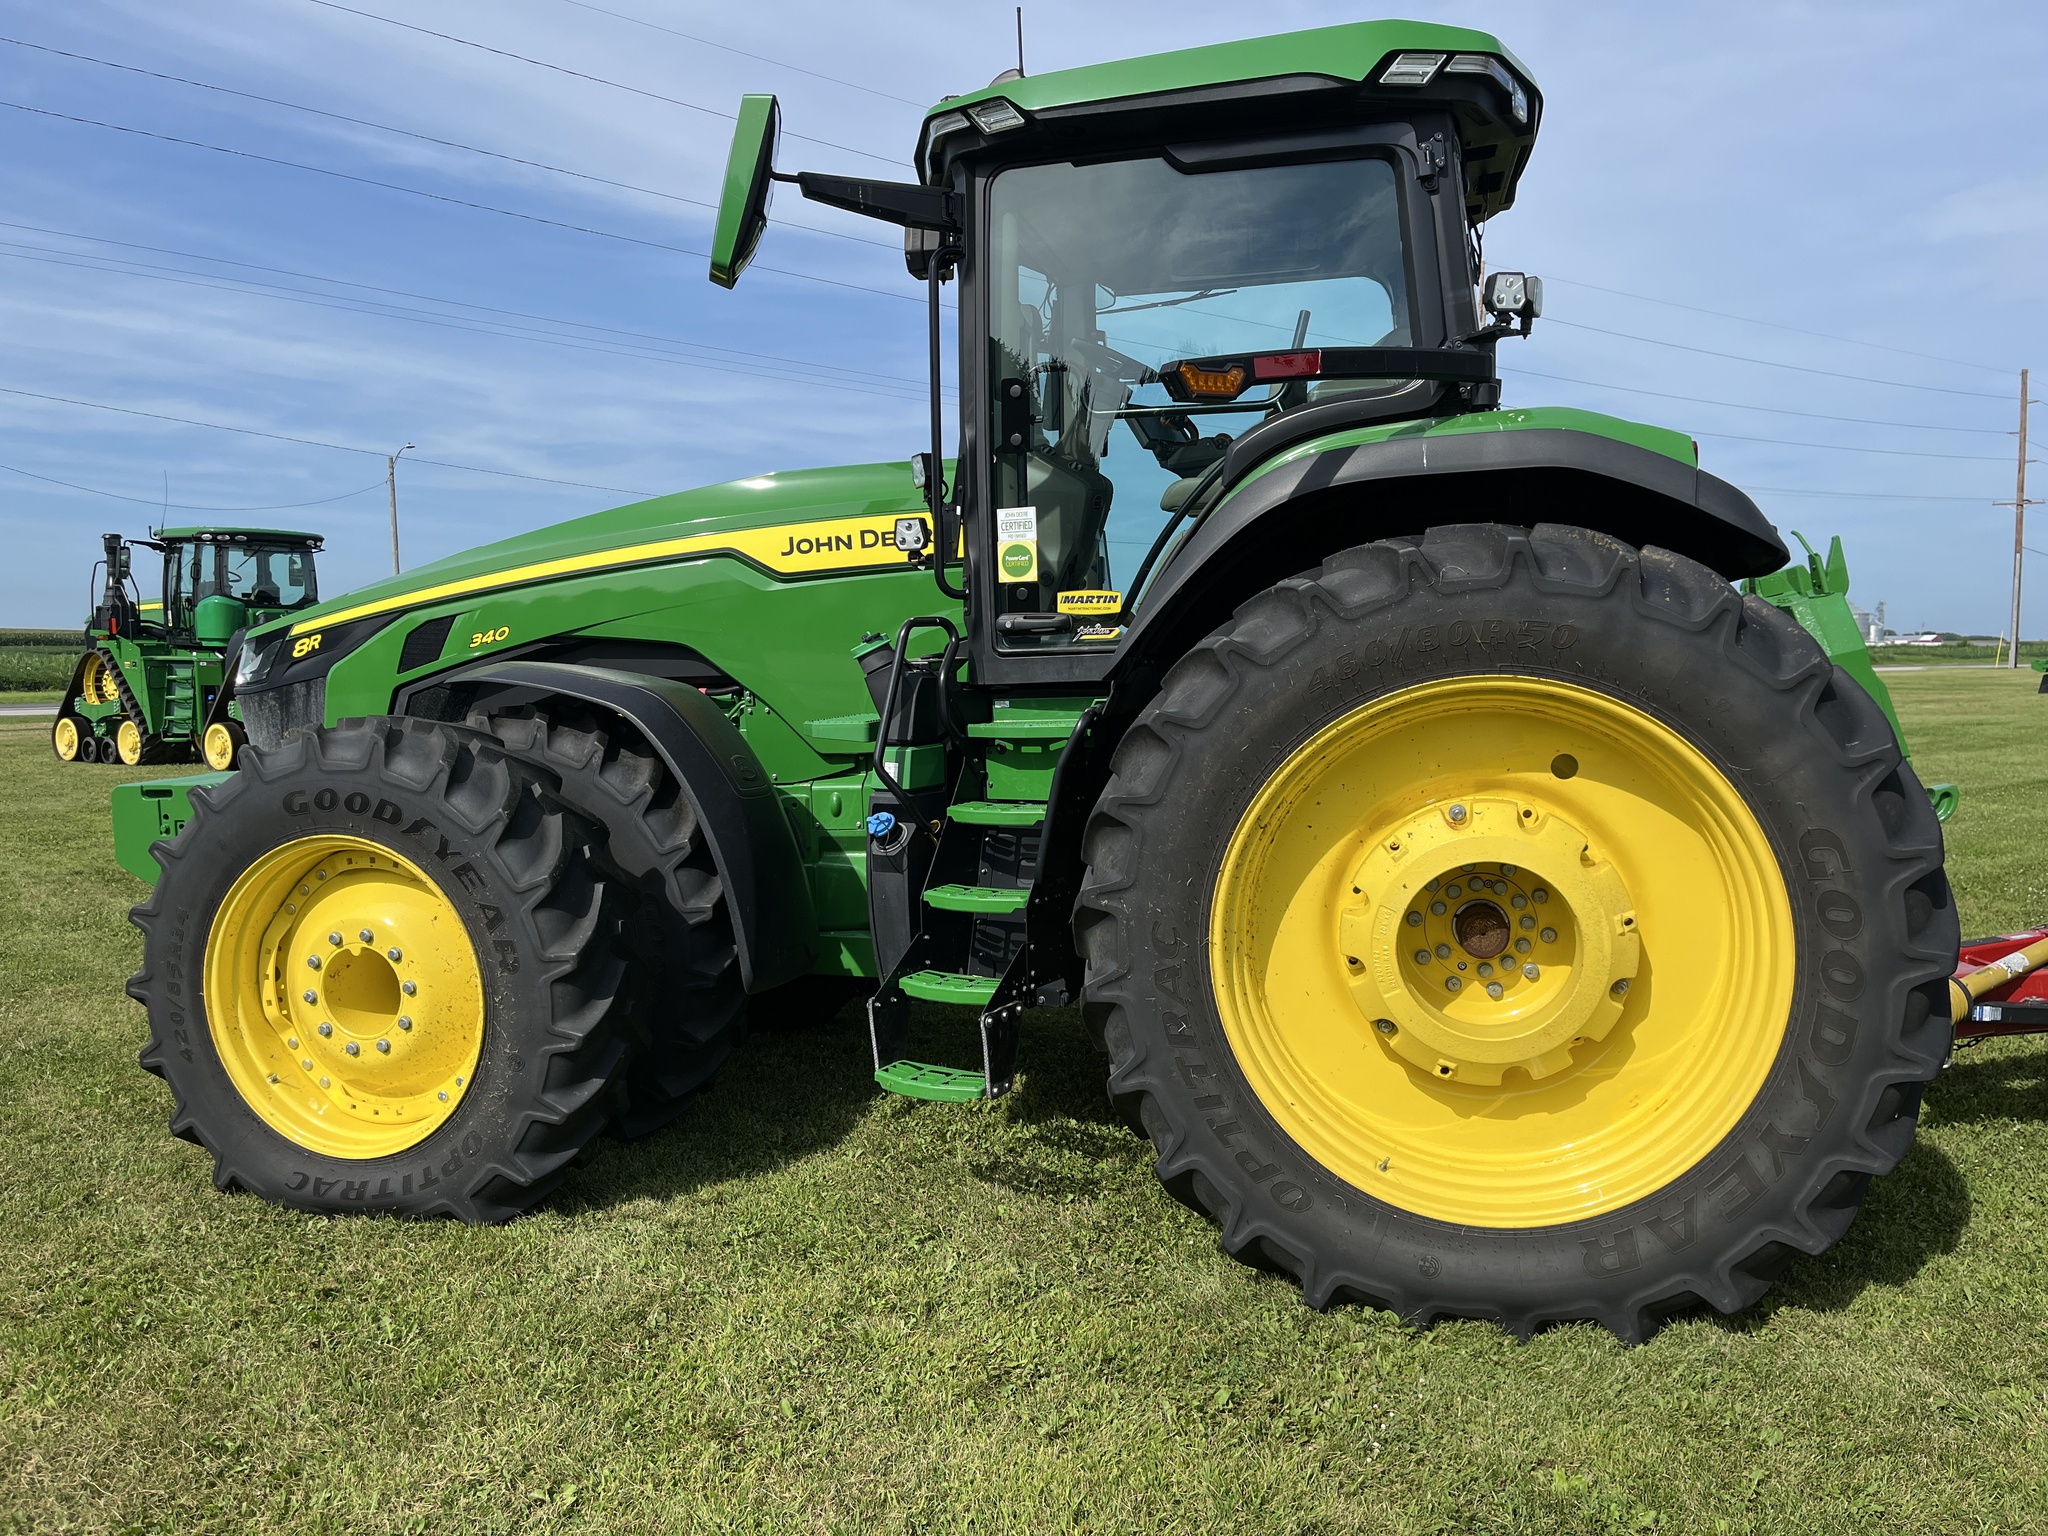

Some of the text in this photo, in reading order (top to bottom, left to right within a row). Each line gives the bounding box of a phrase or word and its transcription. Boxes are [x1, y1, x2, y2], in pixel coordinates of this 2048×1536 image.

[1000, 520, 1033, 532] CERTIFIED
[781, 534, 853, 557] JOHN
[1060, 595, 1119, 604] MARTIN
[292, 634, 322, 658] 8R
[469, 626, 511, 649] 340
[281, 787, 521, 975] GOODYEAR
[1580, 826, 1866, 1279] GOODYEAR
[1152, 919, 1315, 1214] OPTITRAC
[284, 1129, 484, 1203] OPTITRAC
